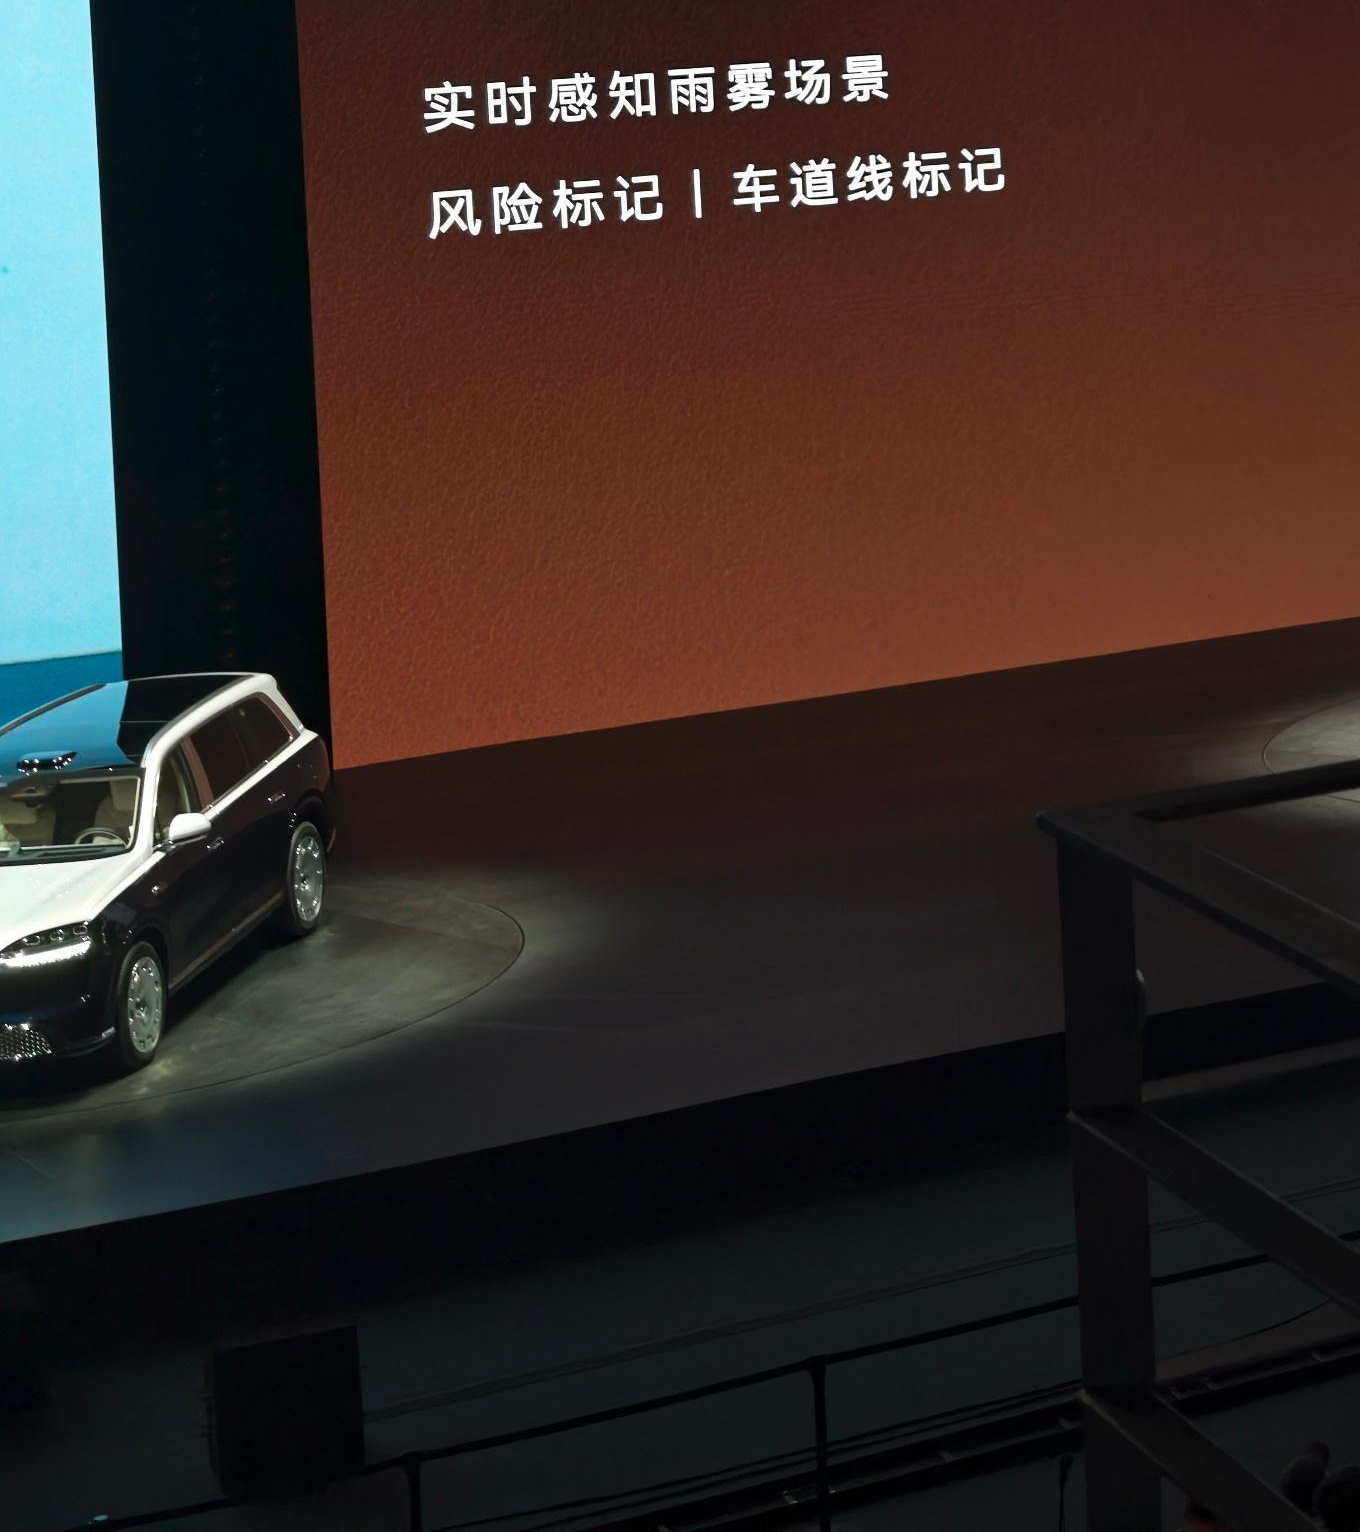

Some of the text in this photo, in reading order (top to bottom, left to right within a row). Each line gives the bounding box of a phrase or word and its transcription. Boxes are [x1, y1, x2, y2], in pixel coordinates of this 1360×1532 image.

[423, 54, 890, 134] 实时感知雨雾场景
[428, 147, 1006, 240] 风险标记 车道线标记
